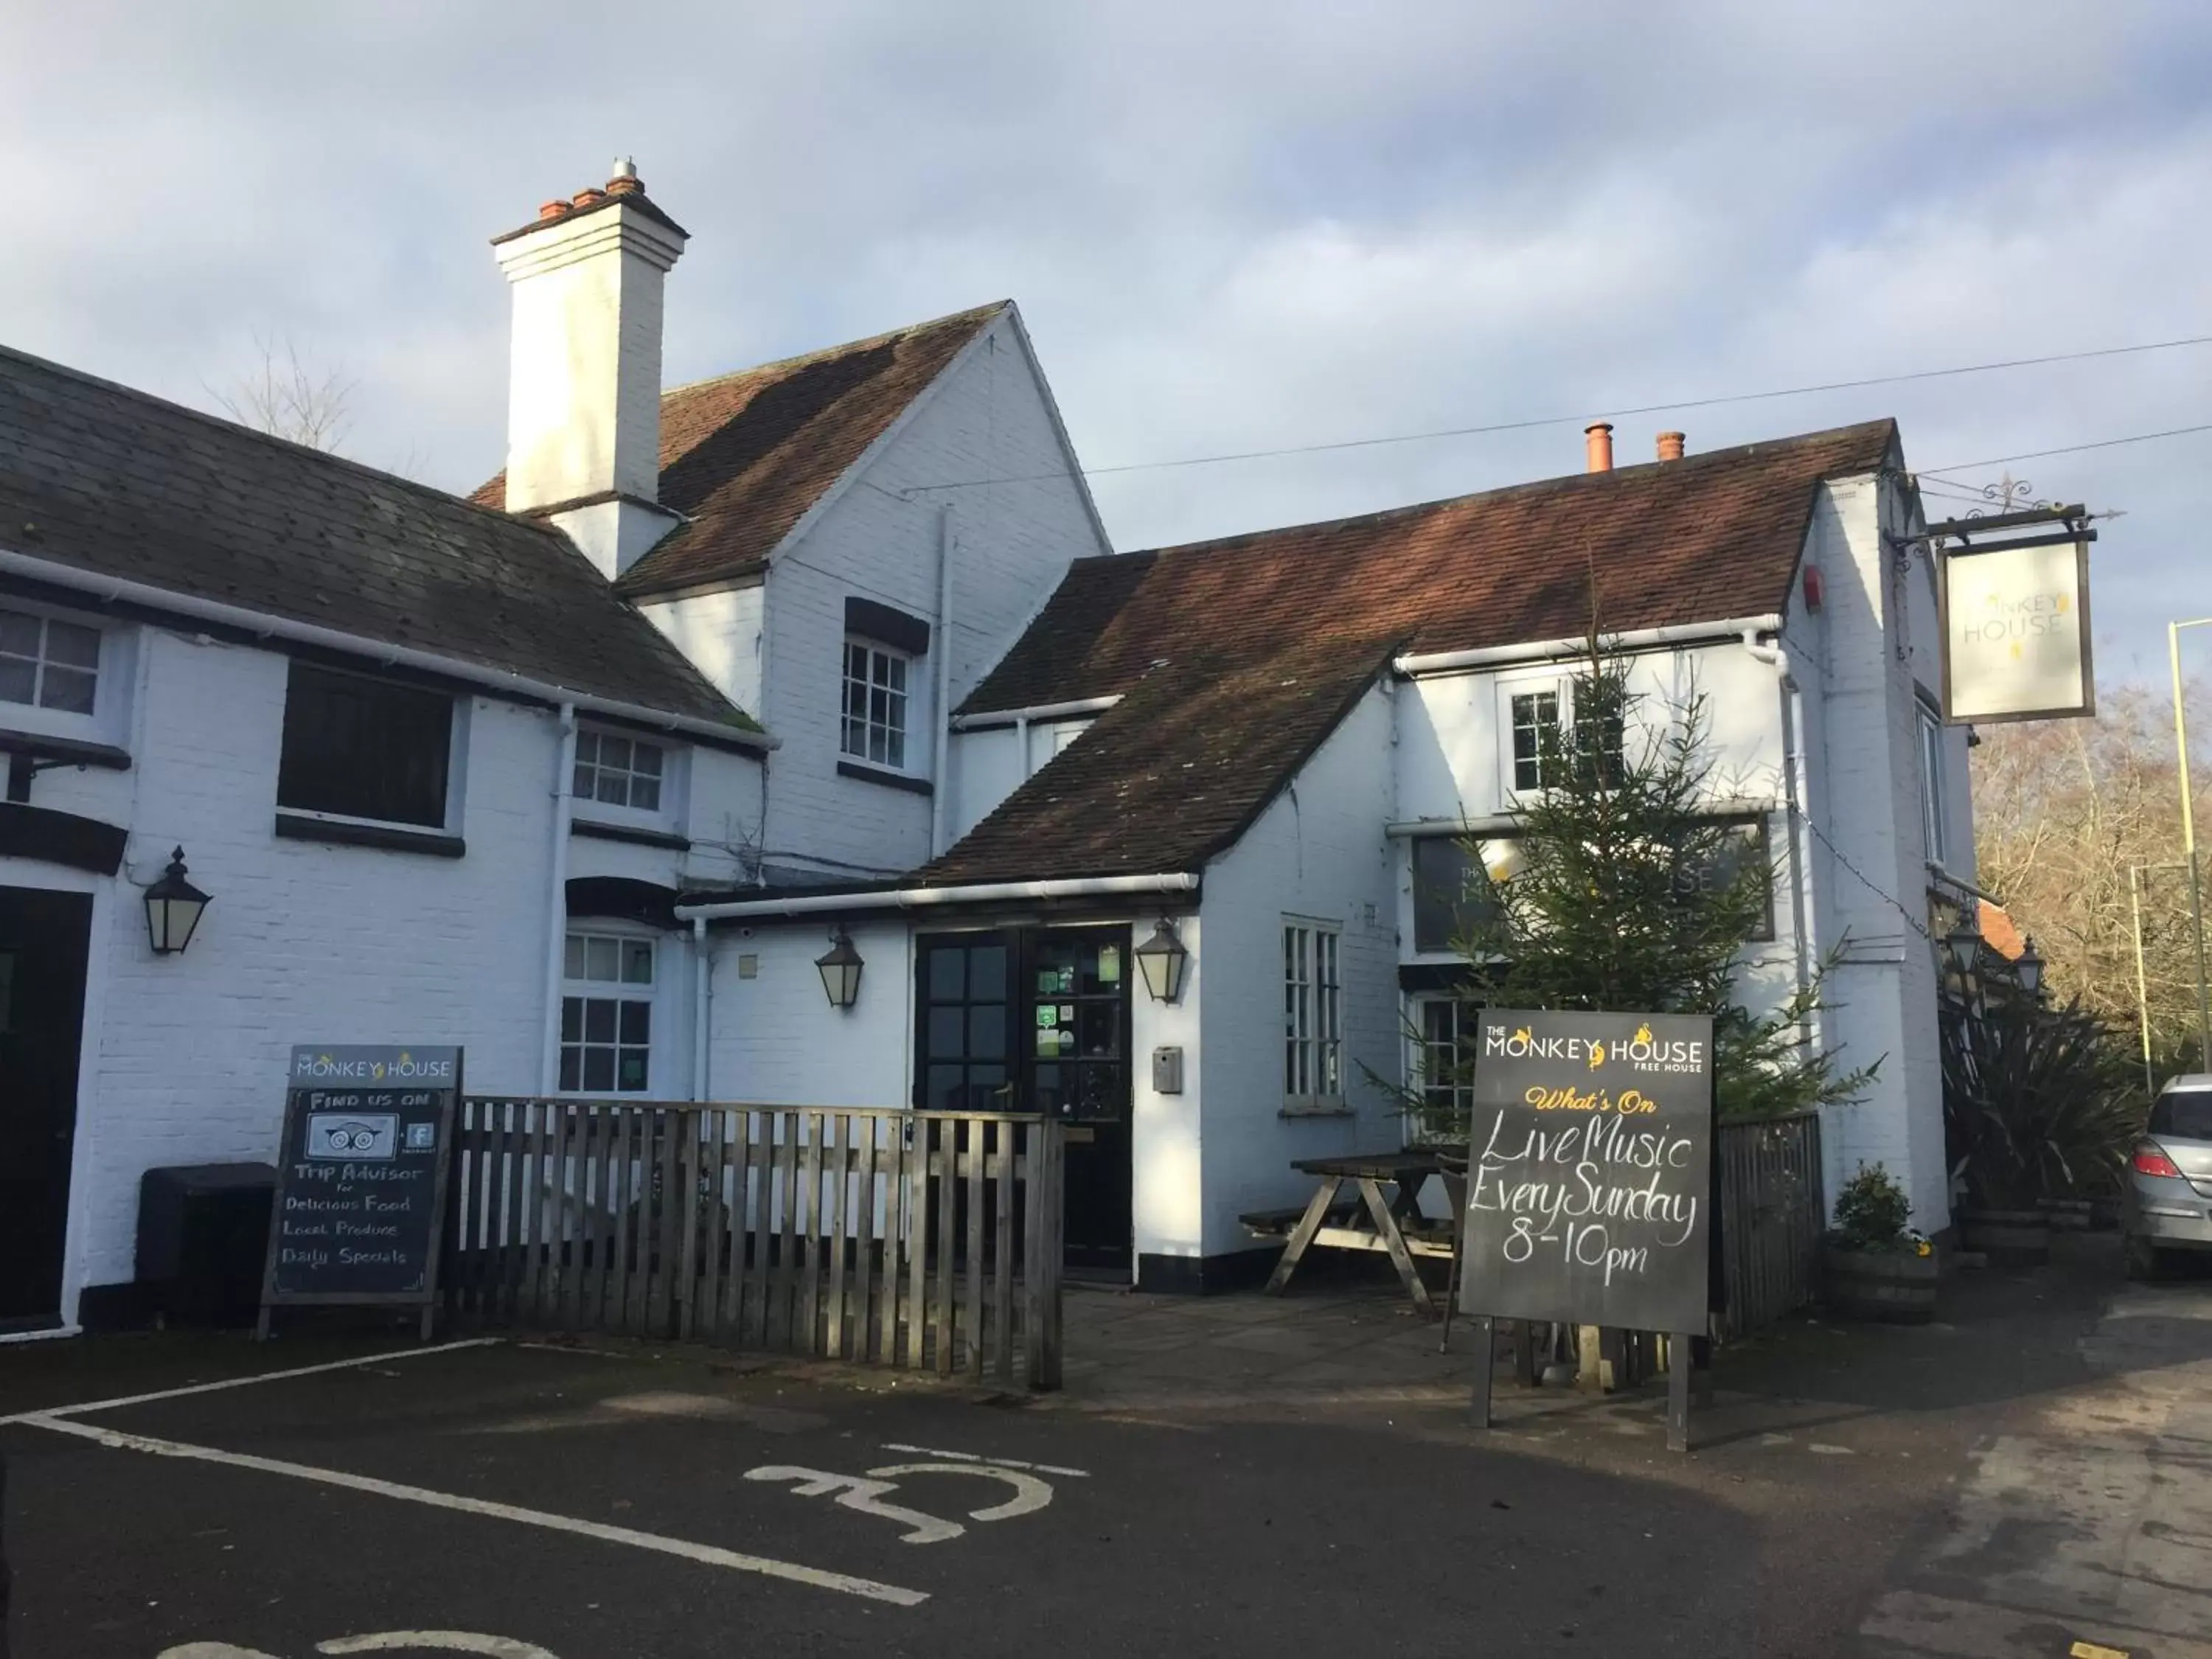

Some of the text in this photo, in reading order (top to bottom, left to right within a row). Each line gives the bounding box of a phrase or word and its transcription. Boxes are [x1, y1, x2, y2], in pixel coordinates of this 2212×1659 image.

[1964, 613, 2063, 644] HOUSE
[1486, 1026, 1506, 1036] THE
[1486, 1037, 1703, 1063] MONKEY HOUSE
[296, 1061, 451, 1078] MONKEY HOUSE
[1635, 1062, 1702, 1073] FREE HOUSE
[1525, 1087, 1657, 1114] What's On
[1481, 1109, 1692, 1168] Live Music
[365, 1195, 411, 1211] Food
[1470, 1161, 1697, 1248] Every Sunday
[1503, 1217, 1648, 1287] 8-10pm
